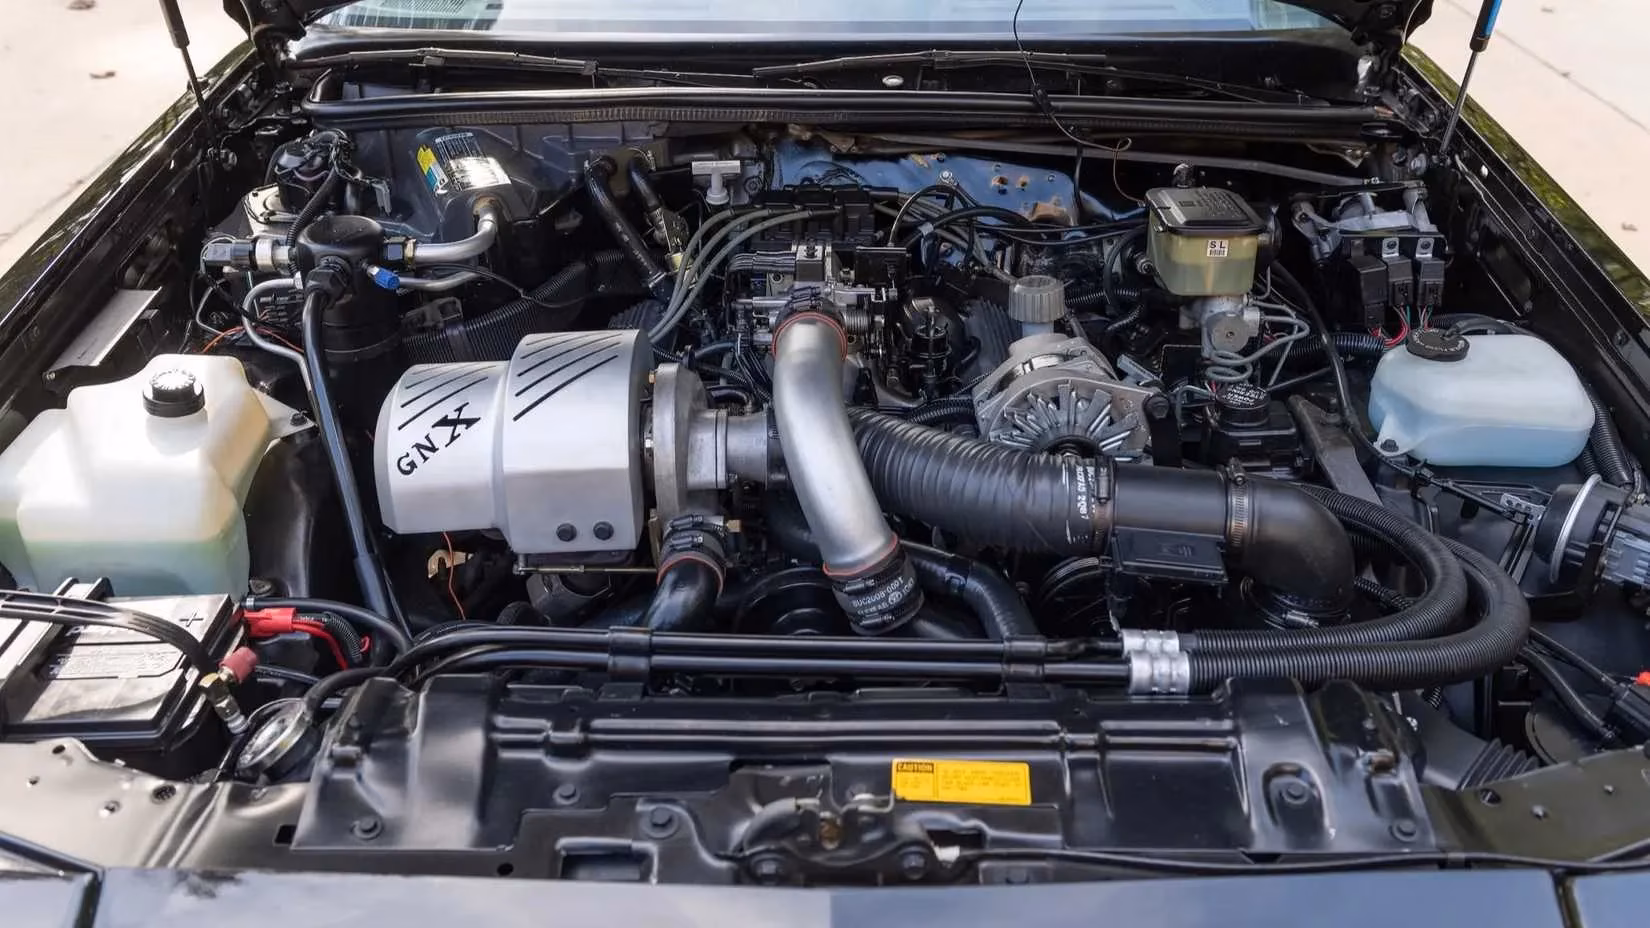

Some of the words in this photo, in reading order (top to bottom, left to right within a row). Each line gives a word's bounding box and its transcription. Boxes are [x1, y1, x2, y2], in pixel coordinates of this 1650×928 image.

[1210, 240, 1217, 248] S
[1220, 240, 1226, 248] L
[397, 402, 481, 476] GNX
